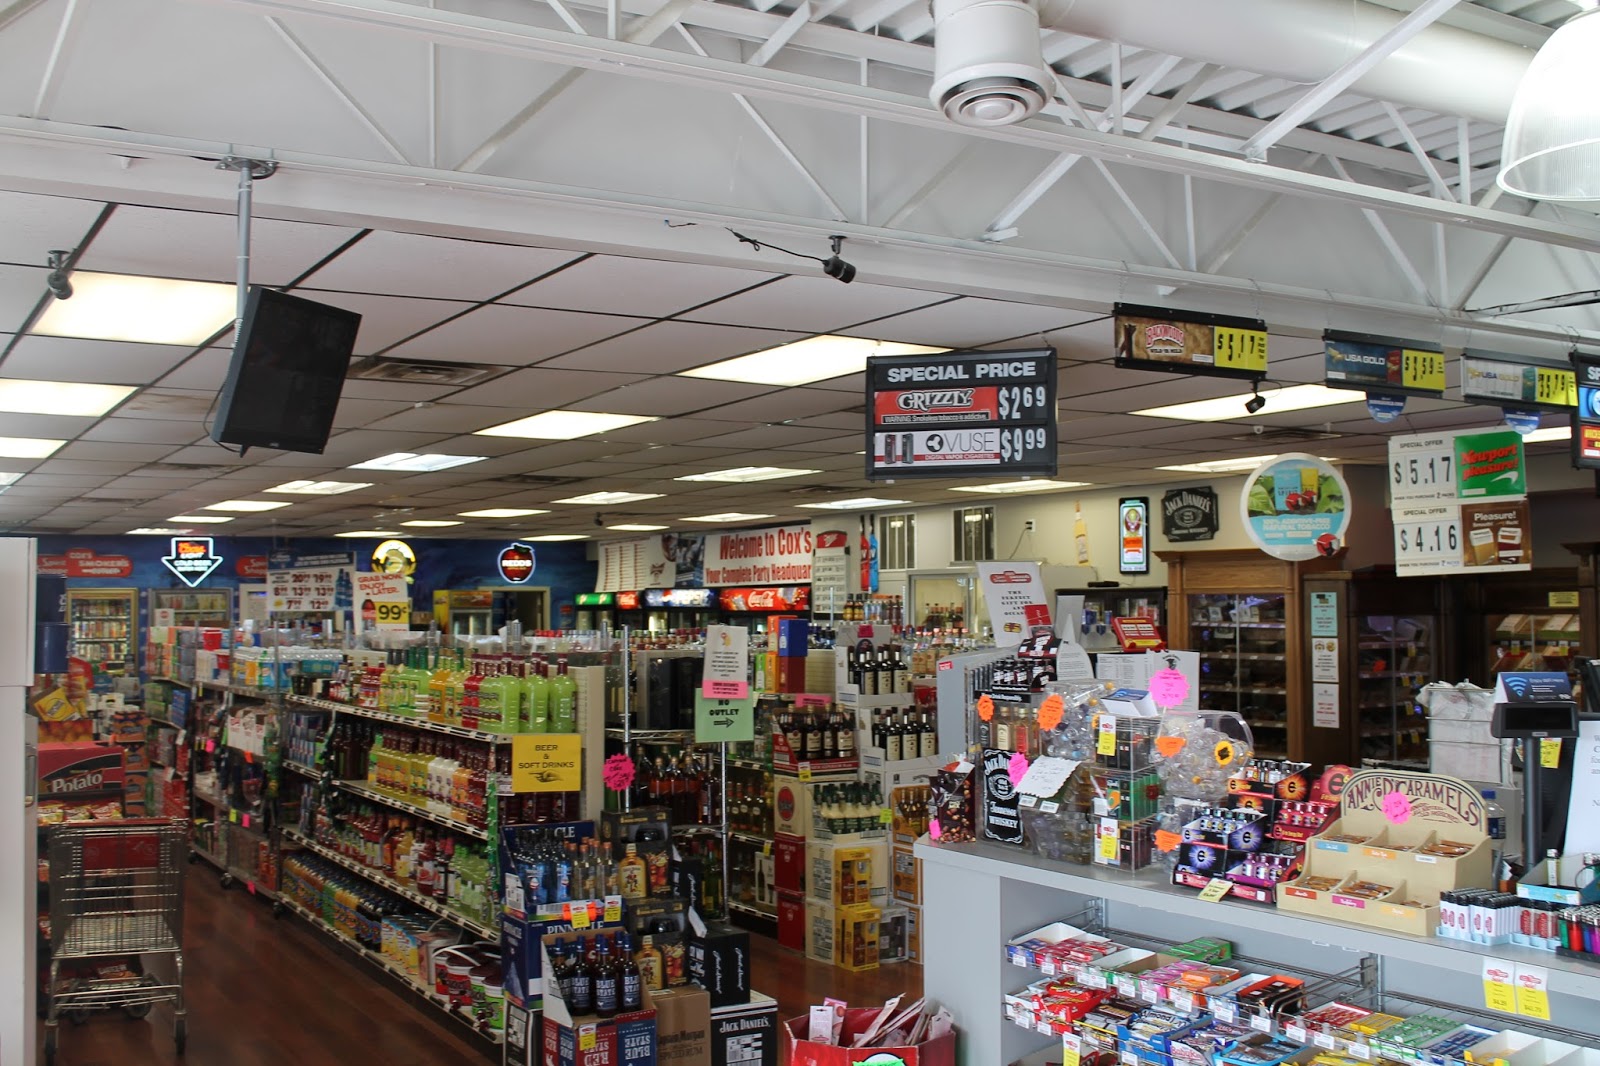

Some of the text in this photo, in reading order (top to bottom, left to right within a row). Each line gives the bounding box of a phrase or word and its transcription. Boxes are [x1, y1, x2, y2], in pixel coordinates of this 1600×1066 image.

[1344, 354, 1385, 365] USA GOLD
[888, 362, 1036, 382] SPECIAL PRICE
[897, 388, 974, 412] GRIZZLY
[944, 432, 994, 452] VUSE
[1460, 445, 1518, 465] Newport
[1462, 458, 1519, 481] pleasure!
[1165, 496, 1182, 516] JACK
[1474, 511, 1516, 521] Pleasure!
[720, 532, 763, 560] Welcome
[765, 536, 775, 556] to
[778, 527, 811, 556] Cox's
[706, 568, 721, 584] Your
[722, 567, 751, 583] Complete
[753, 565, 770, 583] Party
[984, 758, 999, 775] JACK
[52, 773, 102, 792] Potato
[1348, 777, 1381, 809] ANNIE
[1396, 780, 1478, 826] CARAMELS
[989, 815, 1018, 828] WHISKEY
[596, 979, 615, 988] BLUE
[596, 988, 615, 996] STATE
[720, 1016, 769, 1033] JACK DANIEL'S
[625, 1036, 651, 1048] STATE
[625, 1046, 651, 1060] BLUE
